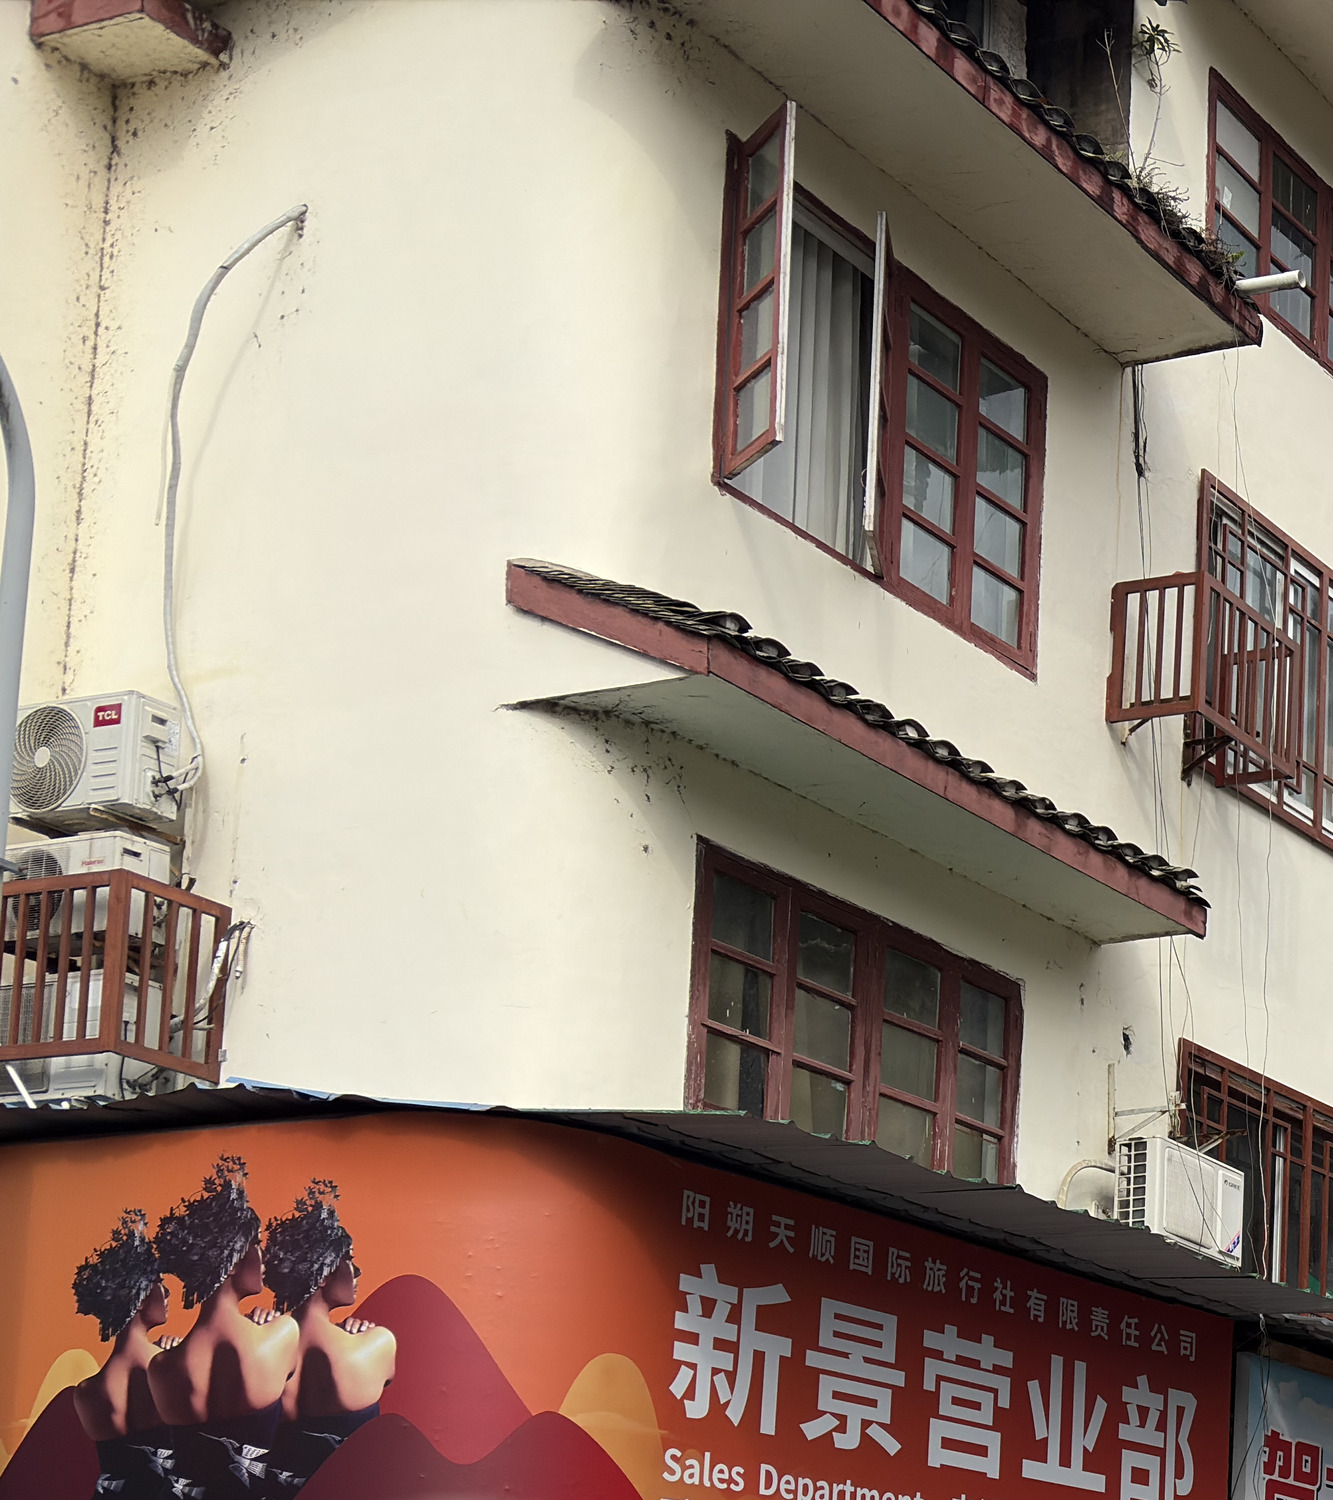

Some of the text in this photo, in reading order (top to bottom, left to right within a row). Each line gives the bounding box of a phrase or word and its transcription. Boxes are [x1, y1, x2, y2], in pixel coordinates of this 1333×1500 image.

[97, 711, 118, 723] TCL
[681, 1189, 1198, 1362] 阳朔天顺国际旅行社有限责任公司
[662, 1448, 745, 1493] Sales
